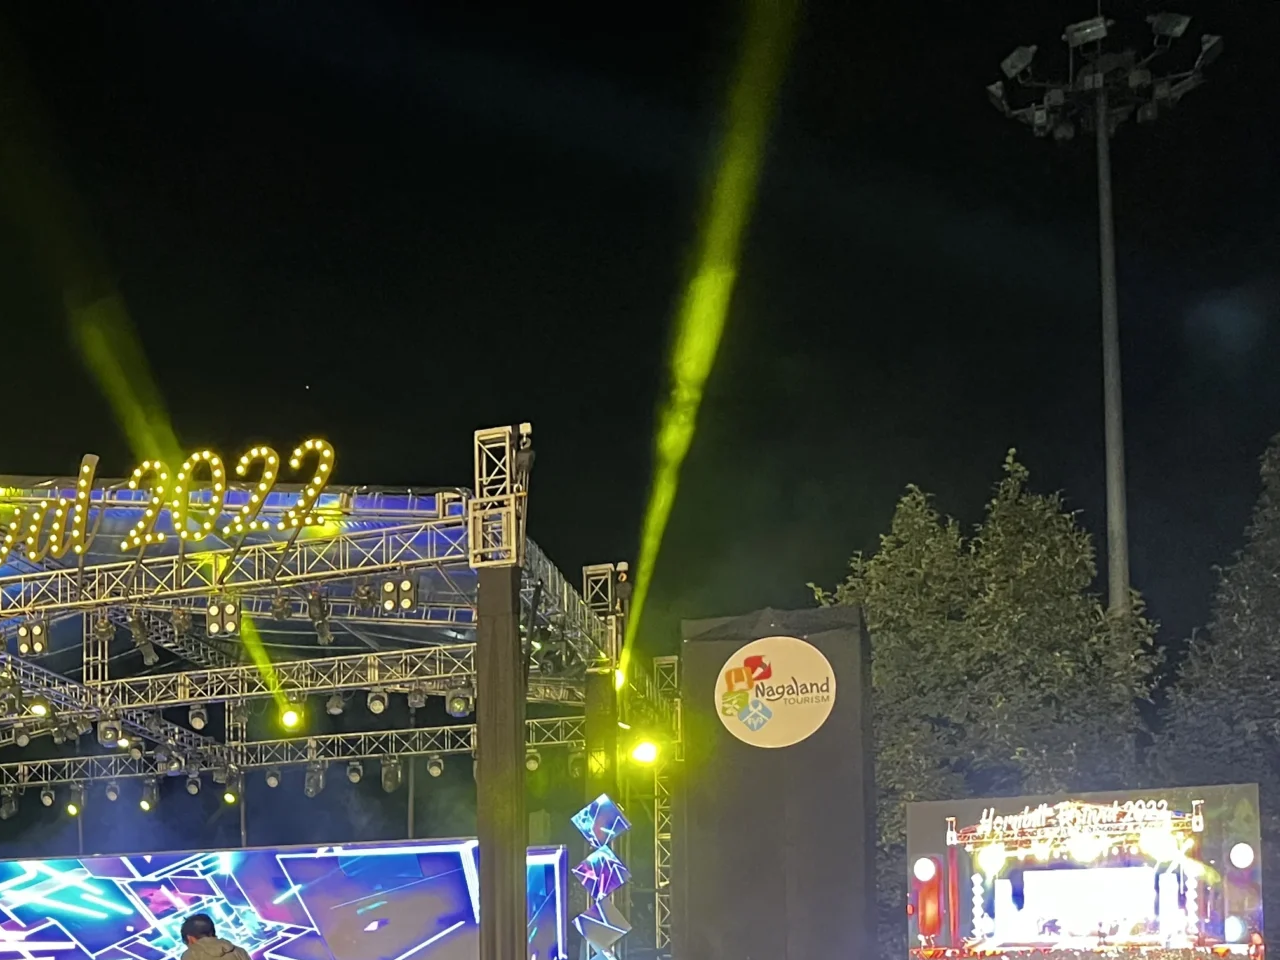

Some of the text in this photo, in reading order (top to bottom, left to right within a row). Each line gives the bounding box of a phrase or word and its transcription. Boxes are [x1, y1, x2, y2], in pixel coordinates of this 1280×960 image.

[120, 438, 335, 551] 2022
[755, 676, 830, 702] Nagaland
[783, 695, 830, 705] TOURISM
